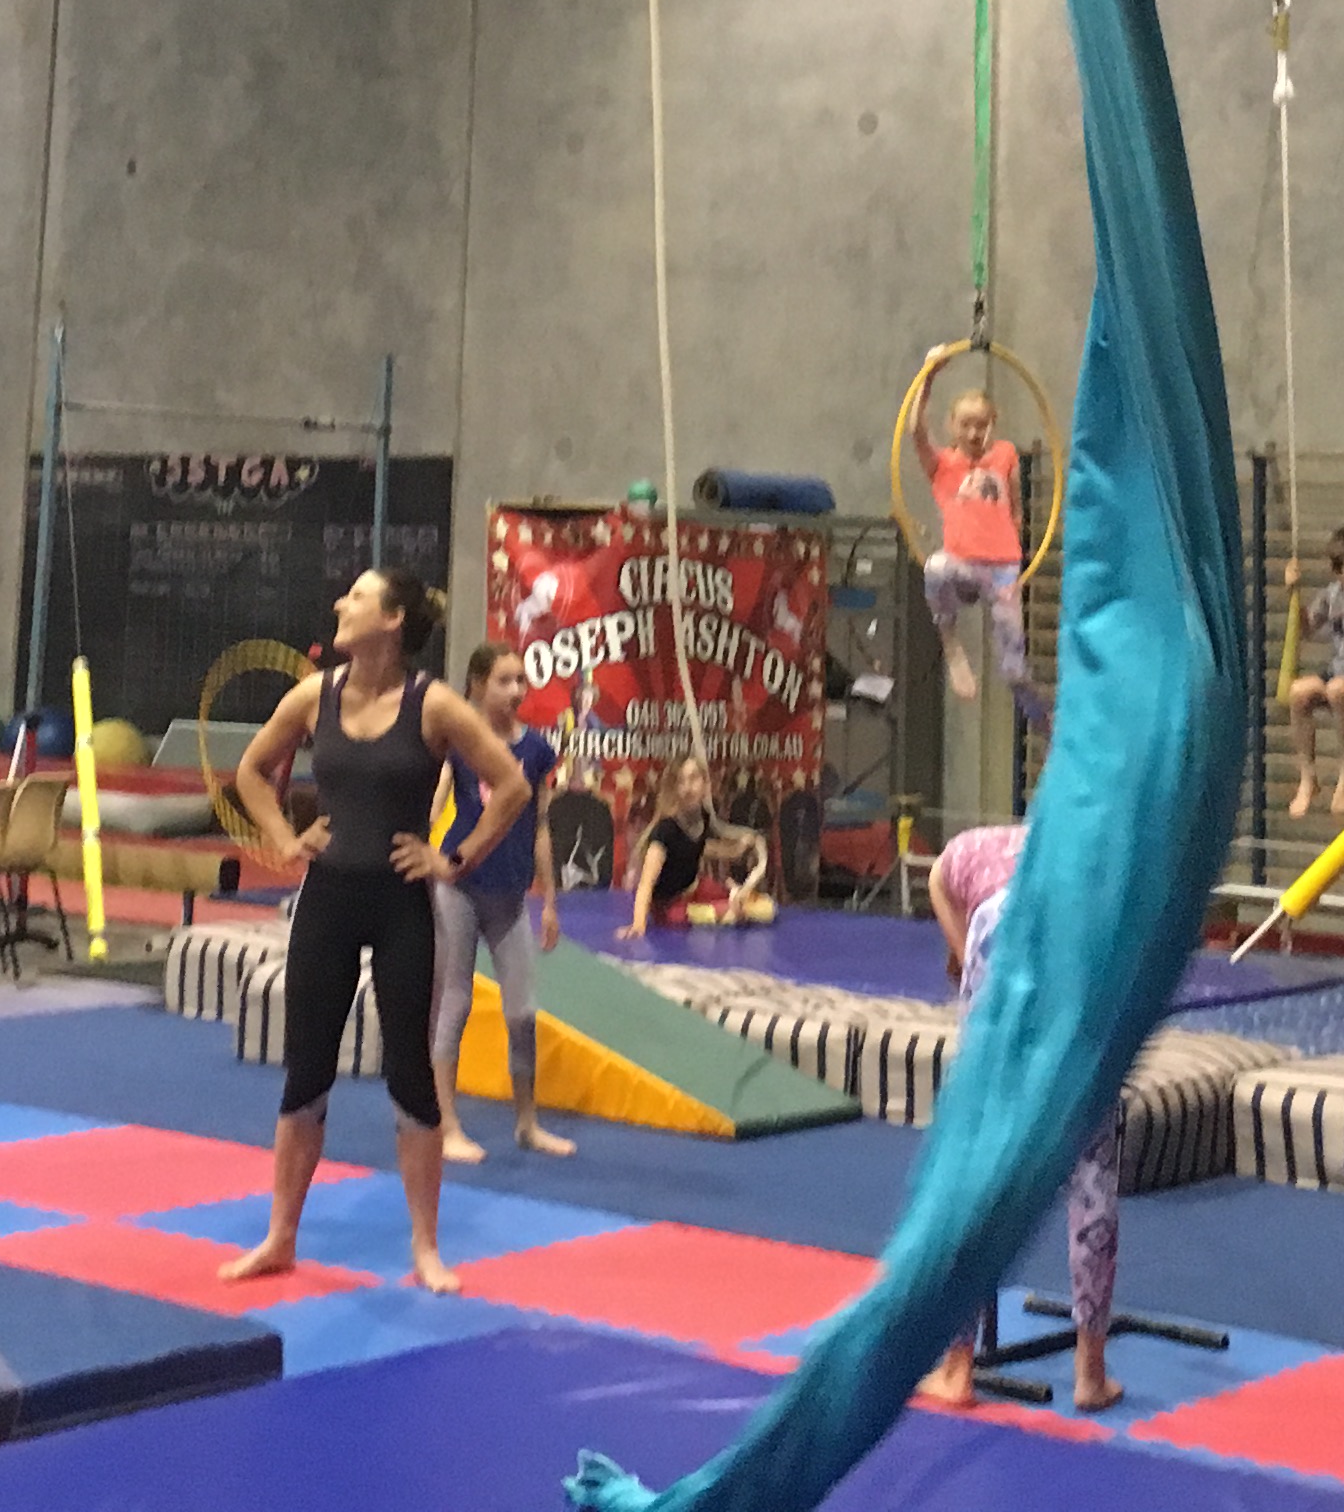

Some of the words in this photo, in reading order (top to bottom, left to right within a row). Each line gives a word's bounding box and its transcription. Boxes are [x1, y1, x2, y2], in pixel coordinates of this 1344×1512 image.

[619, 555, 734, 616] CIRCUS
[523, 606, 655, 689] OSEPH
[676, 605, 804, 714] ASHTON
